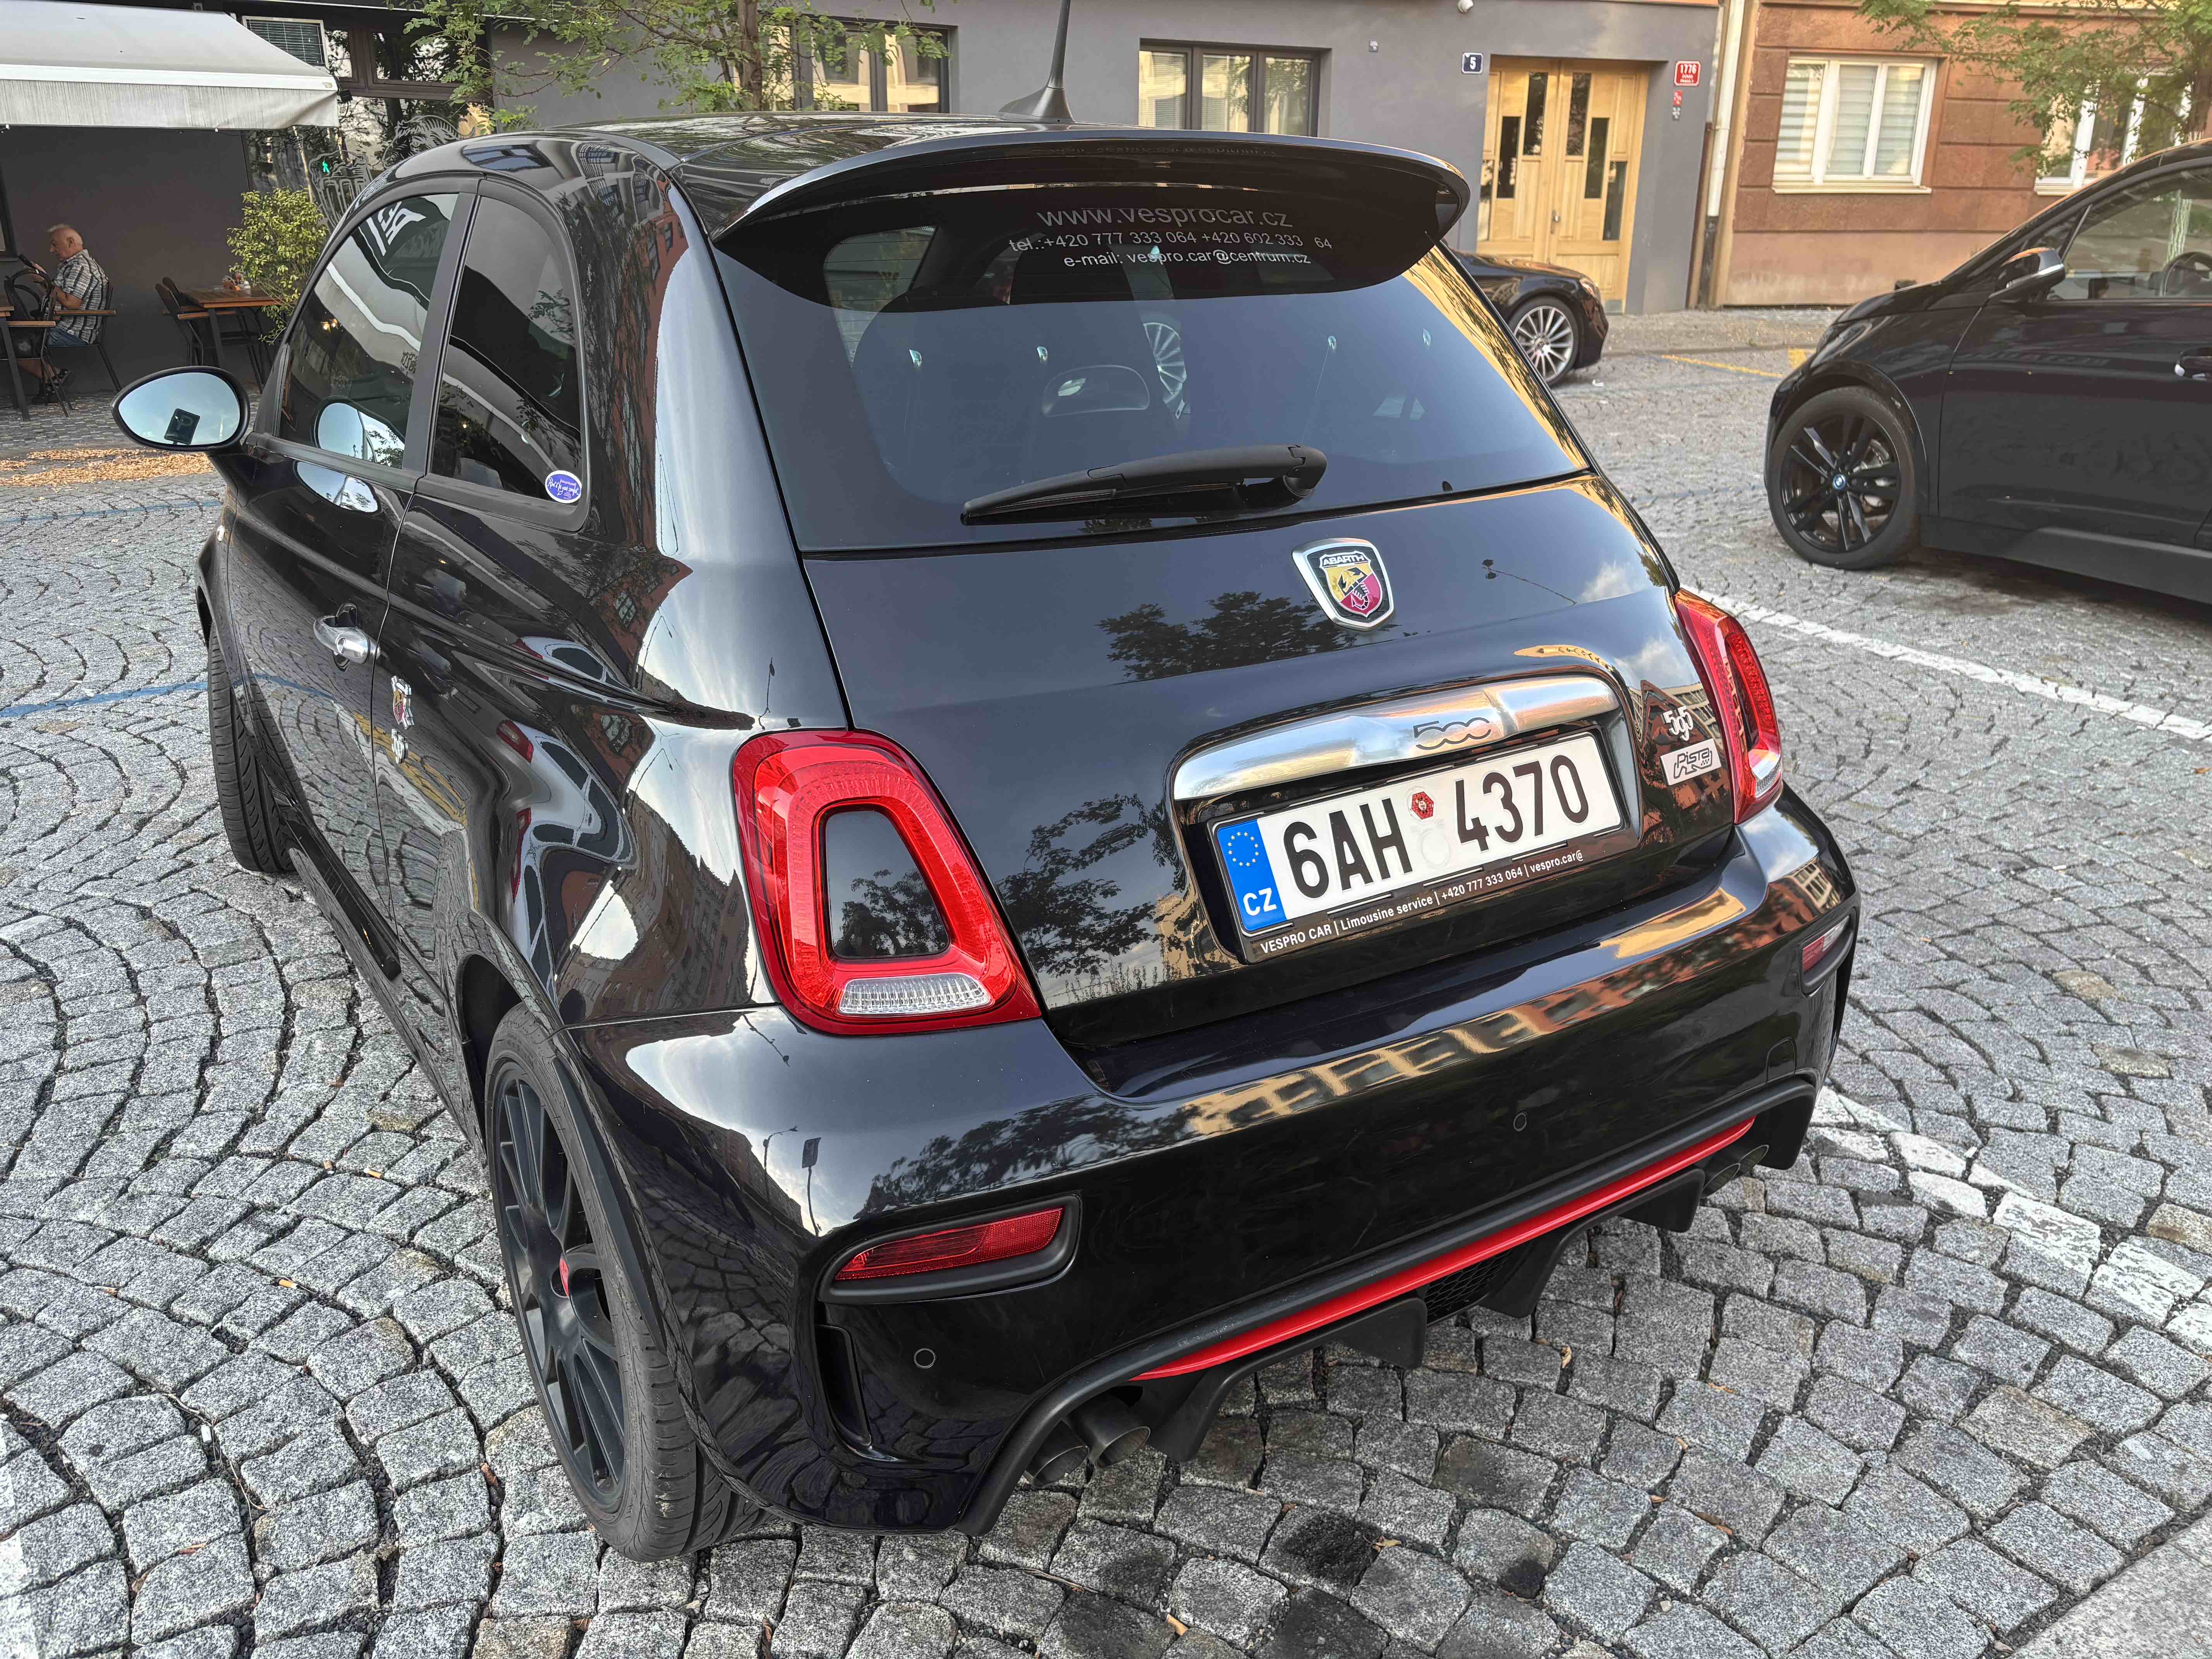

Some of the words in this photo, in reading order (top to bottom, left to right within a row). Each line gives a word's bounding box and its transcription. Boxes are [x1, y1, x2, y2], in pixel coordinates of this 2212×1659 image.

[1470, 57, 1476, 70] 5
[1036, 208, 1293, 227] www.vesprocar.cz
[1091, 232, 1122, 244] 777
[1129, 232, 1161, 244] 333
[1166, 232, 1197, 243] 064
[1202, 232, 1240, 244] +420
[1275, 234, 1303, 246] 333
[1064, 252, 1123, 266] e-mail:
[1126, 249, 1311, 265] vespro.car@centrum.cz
[1323, 555, 1365, 566] ABARTH
[1413, 717, 1491, 750] 500
[1662, 705, 1693, 741] 595
[1284, 798, 1413, 898] 6AH
[1455, 755, 1589, 852] 4370
[1243, 887, 1277, 916] CZ
[1261, 931, 1306, 953] VESPRO
[1308, 924, 1332, 939] CAR
[1340, 908, 1395, 930] Limousine
[1396, 896, 1434, 914] service
[1441, 884, 1465, 900] +420
[1466, 878, 1483, 892] 777
[1486, 872, 1503, 886] 333
[1505, 867, 1523, 881] 064
[1530, 850, 1583, 873] vespro.car@
